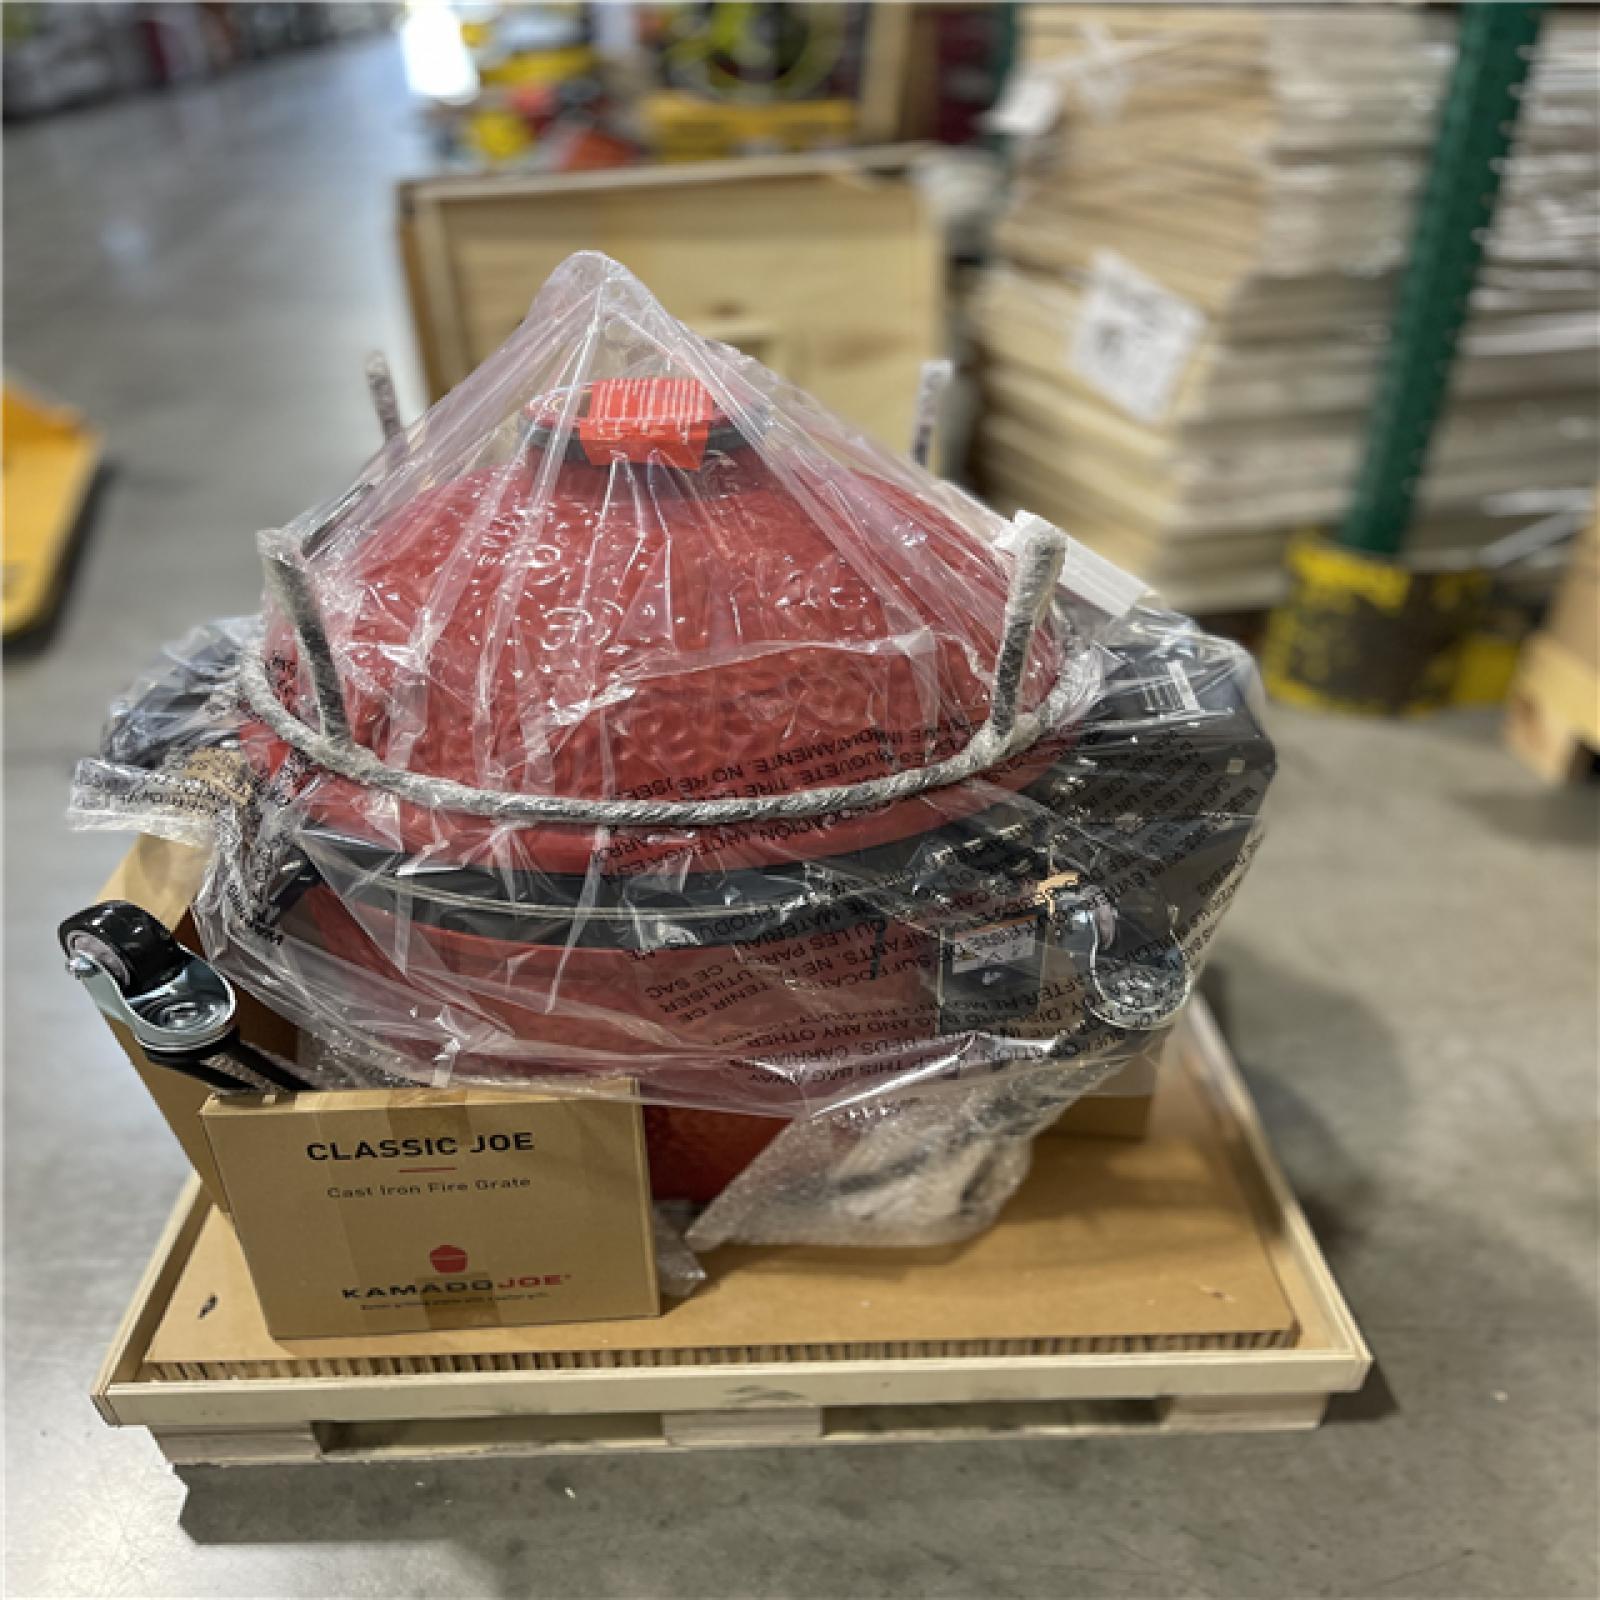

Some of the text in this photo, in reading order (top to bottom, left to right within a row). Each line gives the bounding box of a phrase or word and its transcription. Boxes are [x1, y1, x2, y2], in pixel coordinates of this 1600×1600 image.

[306, 1132, 535, 1161] CLASSIC JOE
[326, 1176, 532, 1199] Cast Iron Fire Grate
